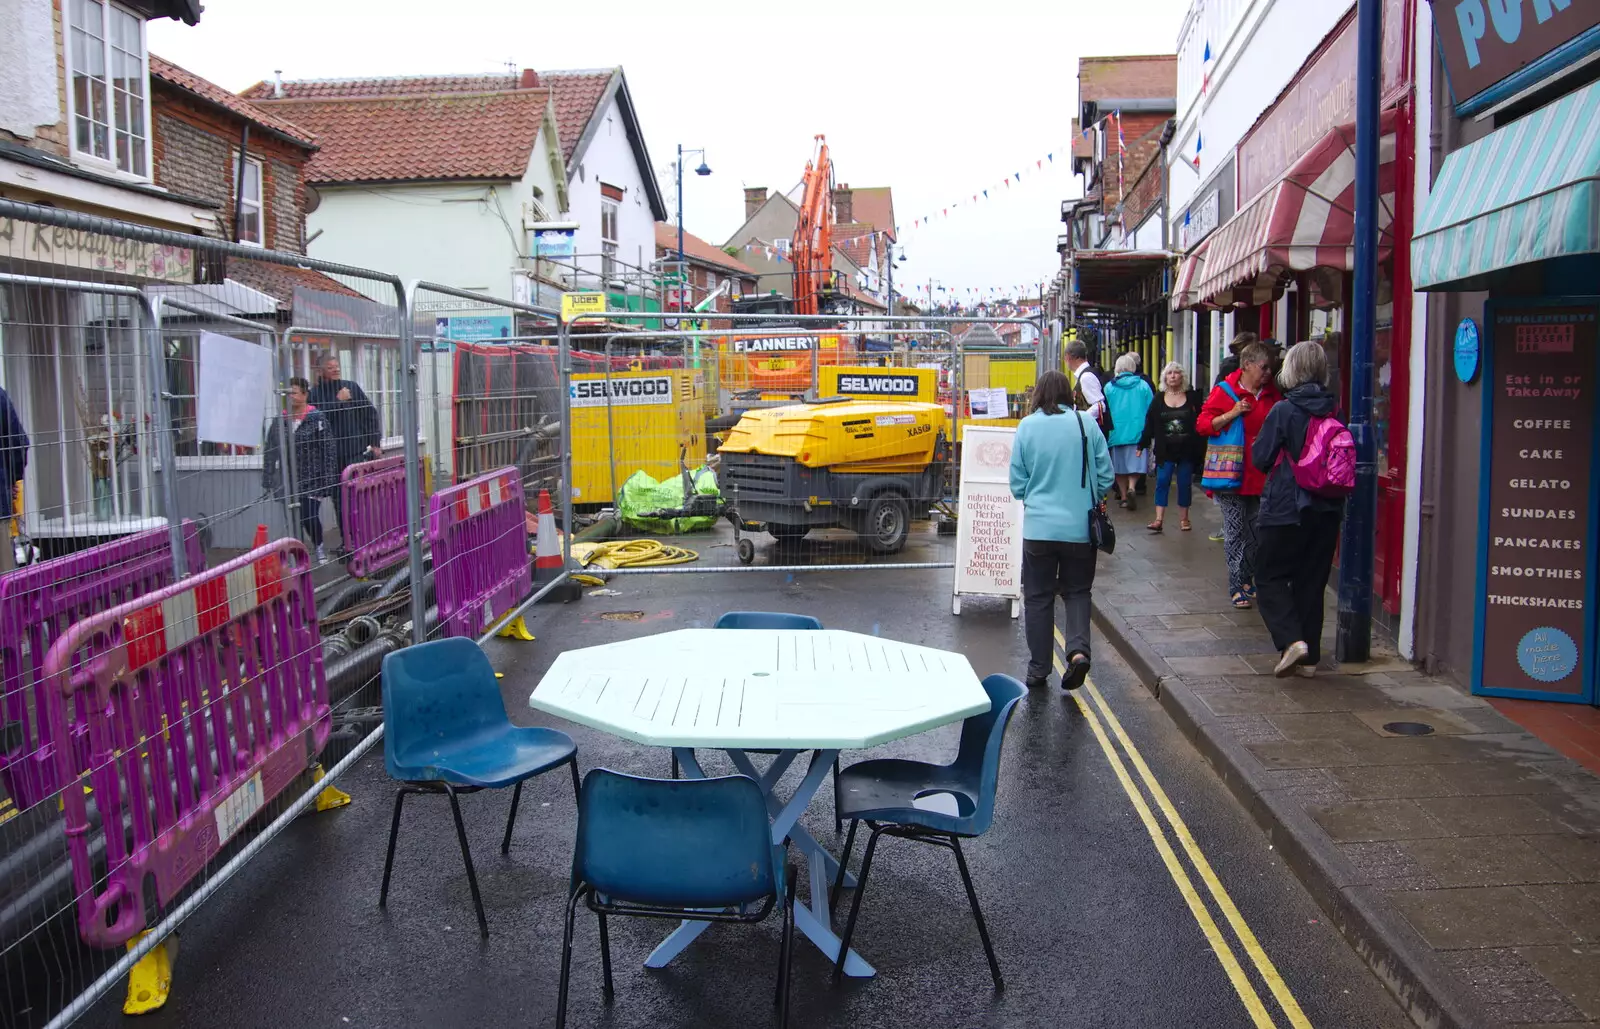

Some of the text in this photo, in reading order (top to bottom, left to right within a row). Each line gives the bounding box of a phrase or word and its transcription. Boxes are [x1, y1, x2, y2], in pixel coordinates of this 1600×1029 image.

[735, 337, 819, 352] FLANNERY
[1506, 374, 1581, 384] Eat in or
[577, 379, 669, 398] SELWOOD
[841, 377, 915, 392] SELWOOD
[1506, 387, 1580, 399] Take Away
[1513, 420, 1571, 429] COFFEE
[1519, 449, 1563, 459] CAKE
[1509, 479, 1571, 489] GELATO
[967, 494, 1011, 503] nutritional
[967, 502, 995, 510] advice
[976, 510, 1004, 519] Herbal
[1501, 508, 1576, 519] SUNDAES
[972, 526, 1005, 537] Food for
[970, 535, 1011, 545] specialist
[1494, 537, 1581, 549] PANCAKES
[974, 551, 1007, 561] Natural
[964, 567, 987, 576] Toxic
[1491, 566, 1582, 579] SMOOTHIES
[994, 578, 1013, 587] food
[1488, 595, 1583, 609] THICKSHAKES
[1525, 643, 1559, 655] made
[1533, 654, 1561, 663] here
[1532, 663, 1548, 676] by
